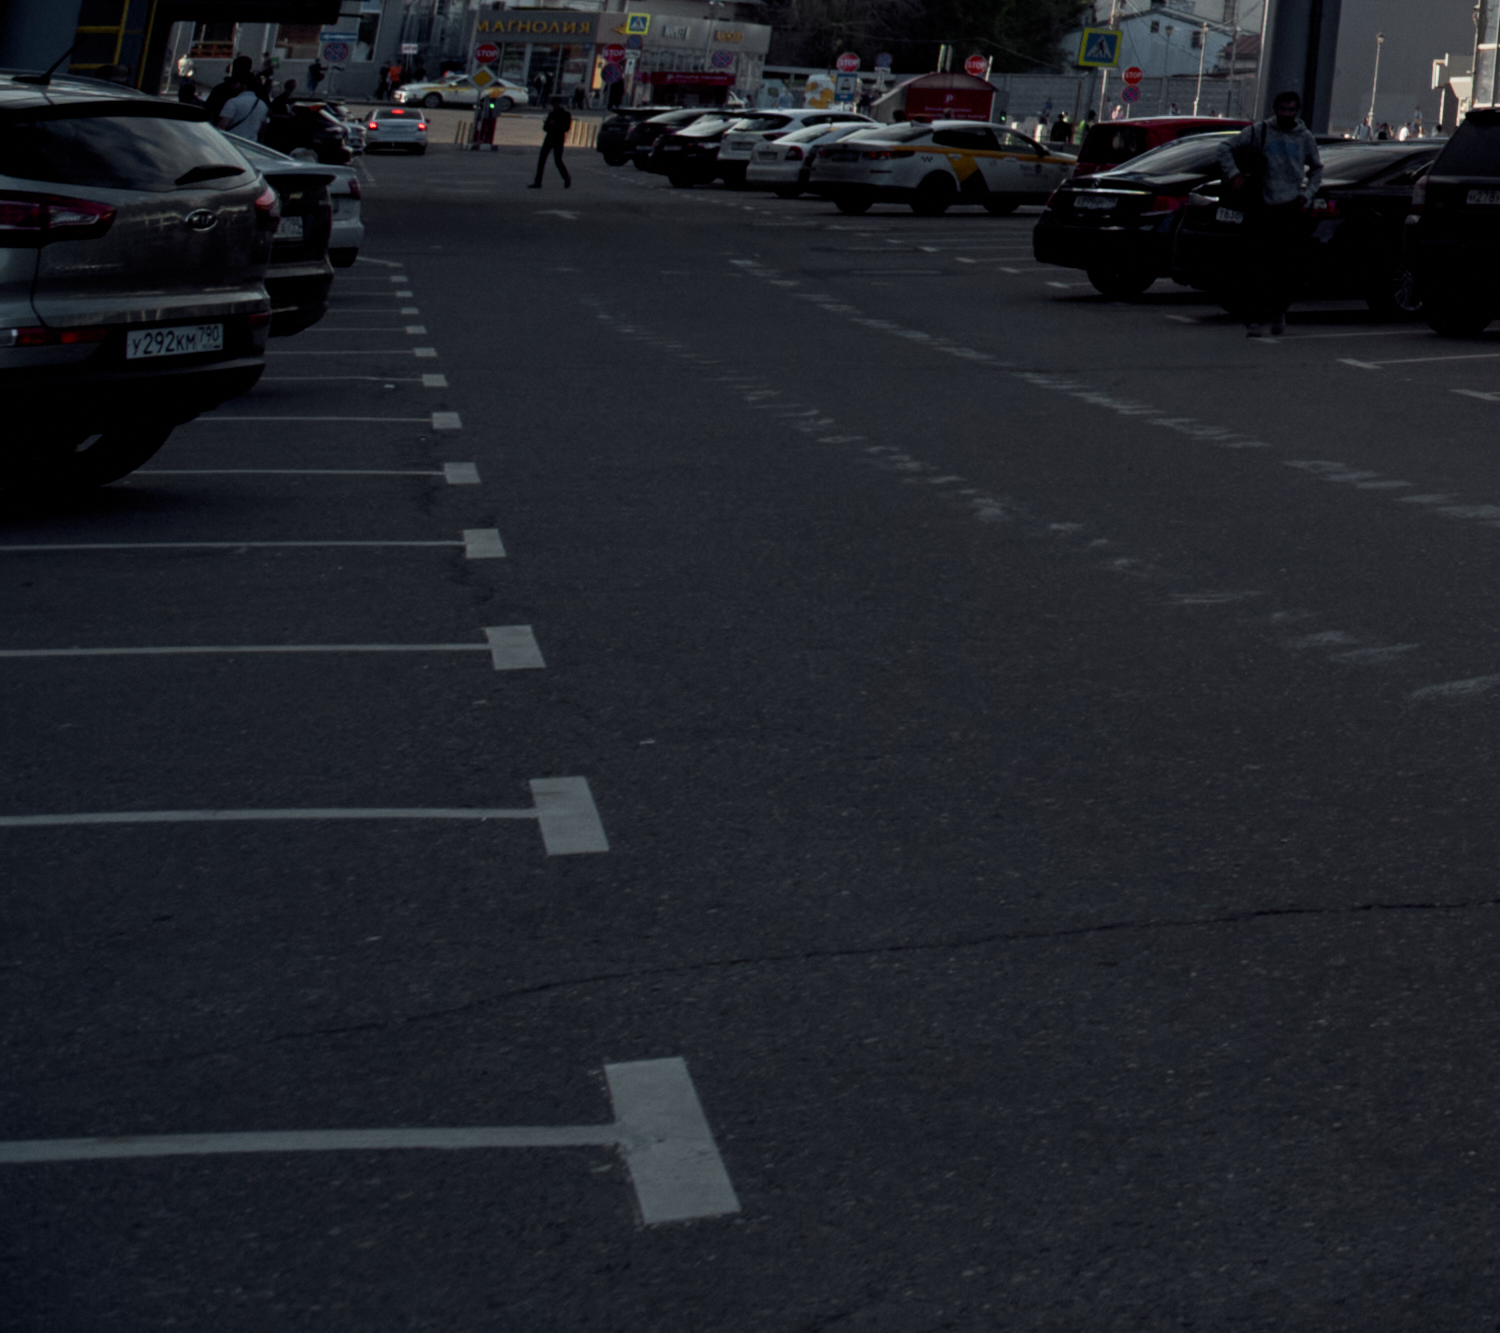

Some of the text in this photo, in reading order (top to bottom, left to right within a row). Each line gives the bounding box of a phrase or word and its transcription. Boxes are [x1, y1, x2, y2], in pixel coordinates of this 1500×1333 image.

[478, 20, 591, 33] МАГНОЛИЯ
[476, 49, 498, 58] STOP
[603, 49, 626, 58] STOP
